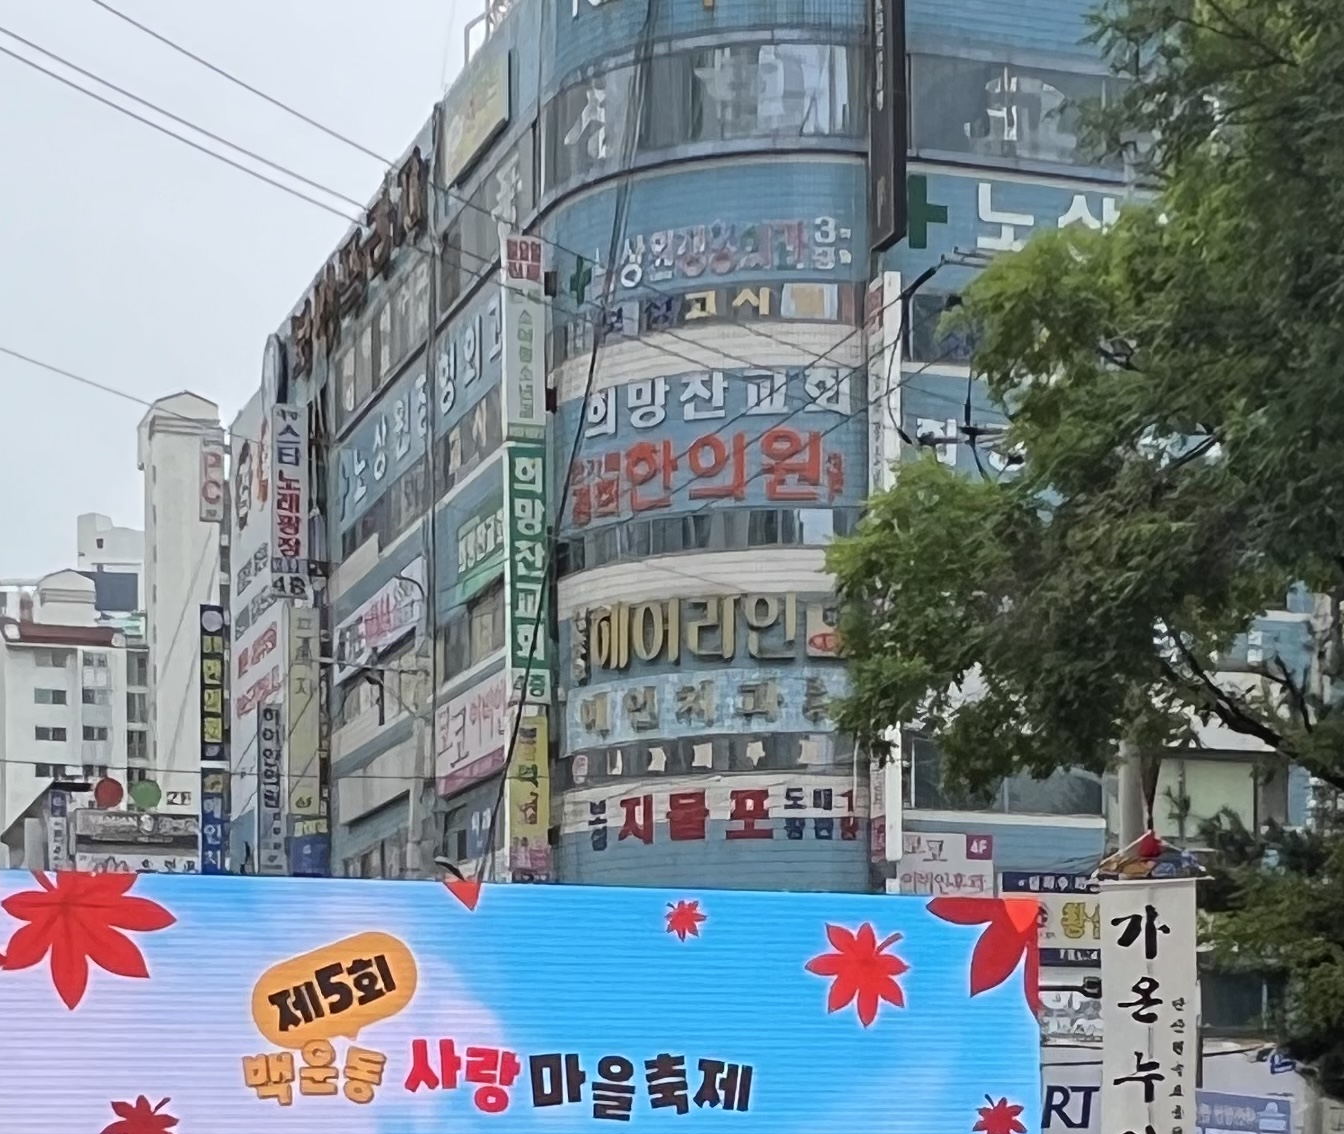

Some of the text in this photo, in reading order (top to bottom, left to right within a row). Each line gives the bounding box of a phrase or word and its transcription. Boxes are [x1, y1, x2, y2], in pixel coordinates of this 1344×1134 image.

[626, 427, 824, 512] 한의원
[617, 786, 774, 846] 지물포
[268, 953, 397, 1034] 제5회
[242, 1038, 754, 1122] 백운동 사랑 마을축제
